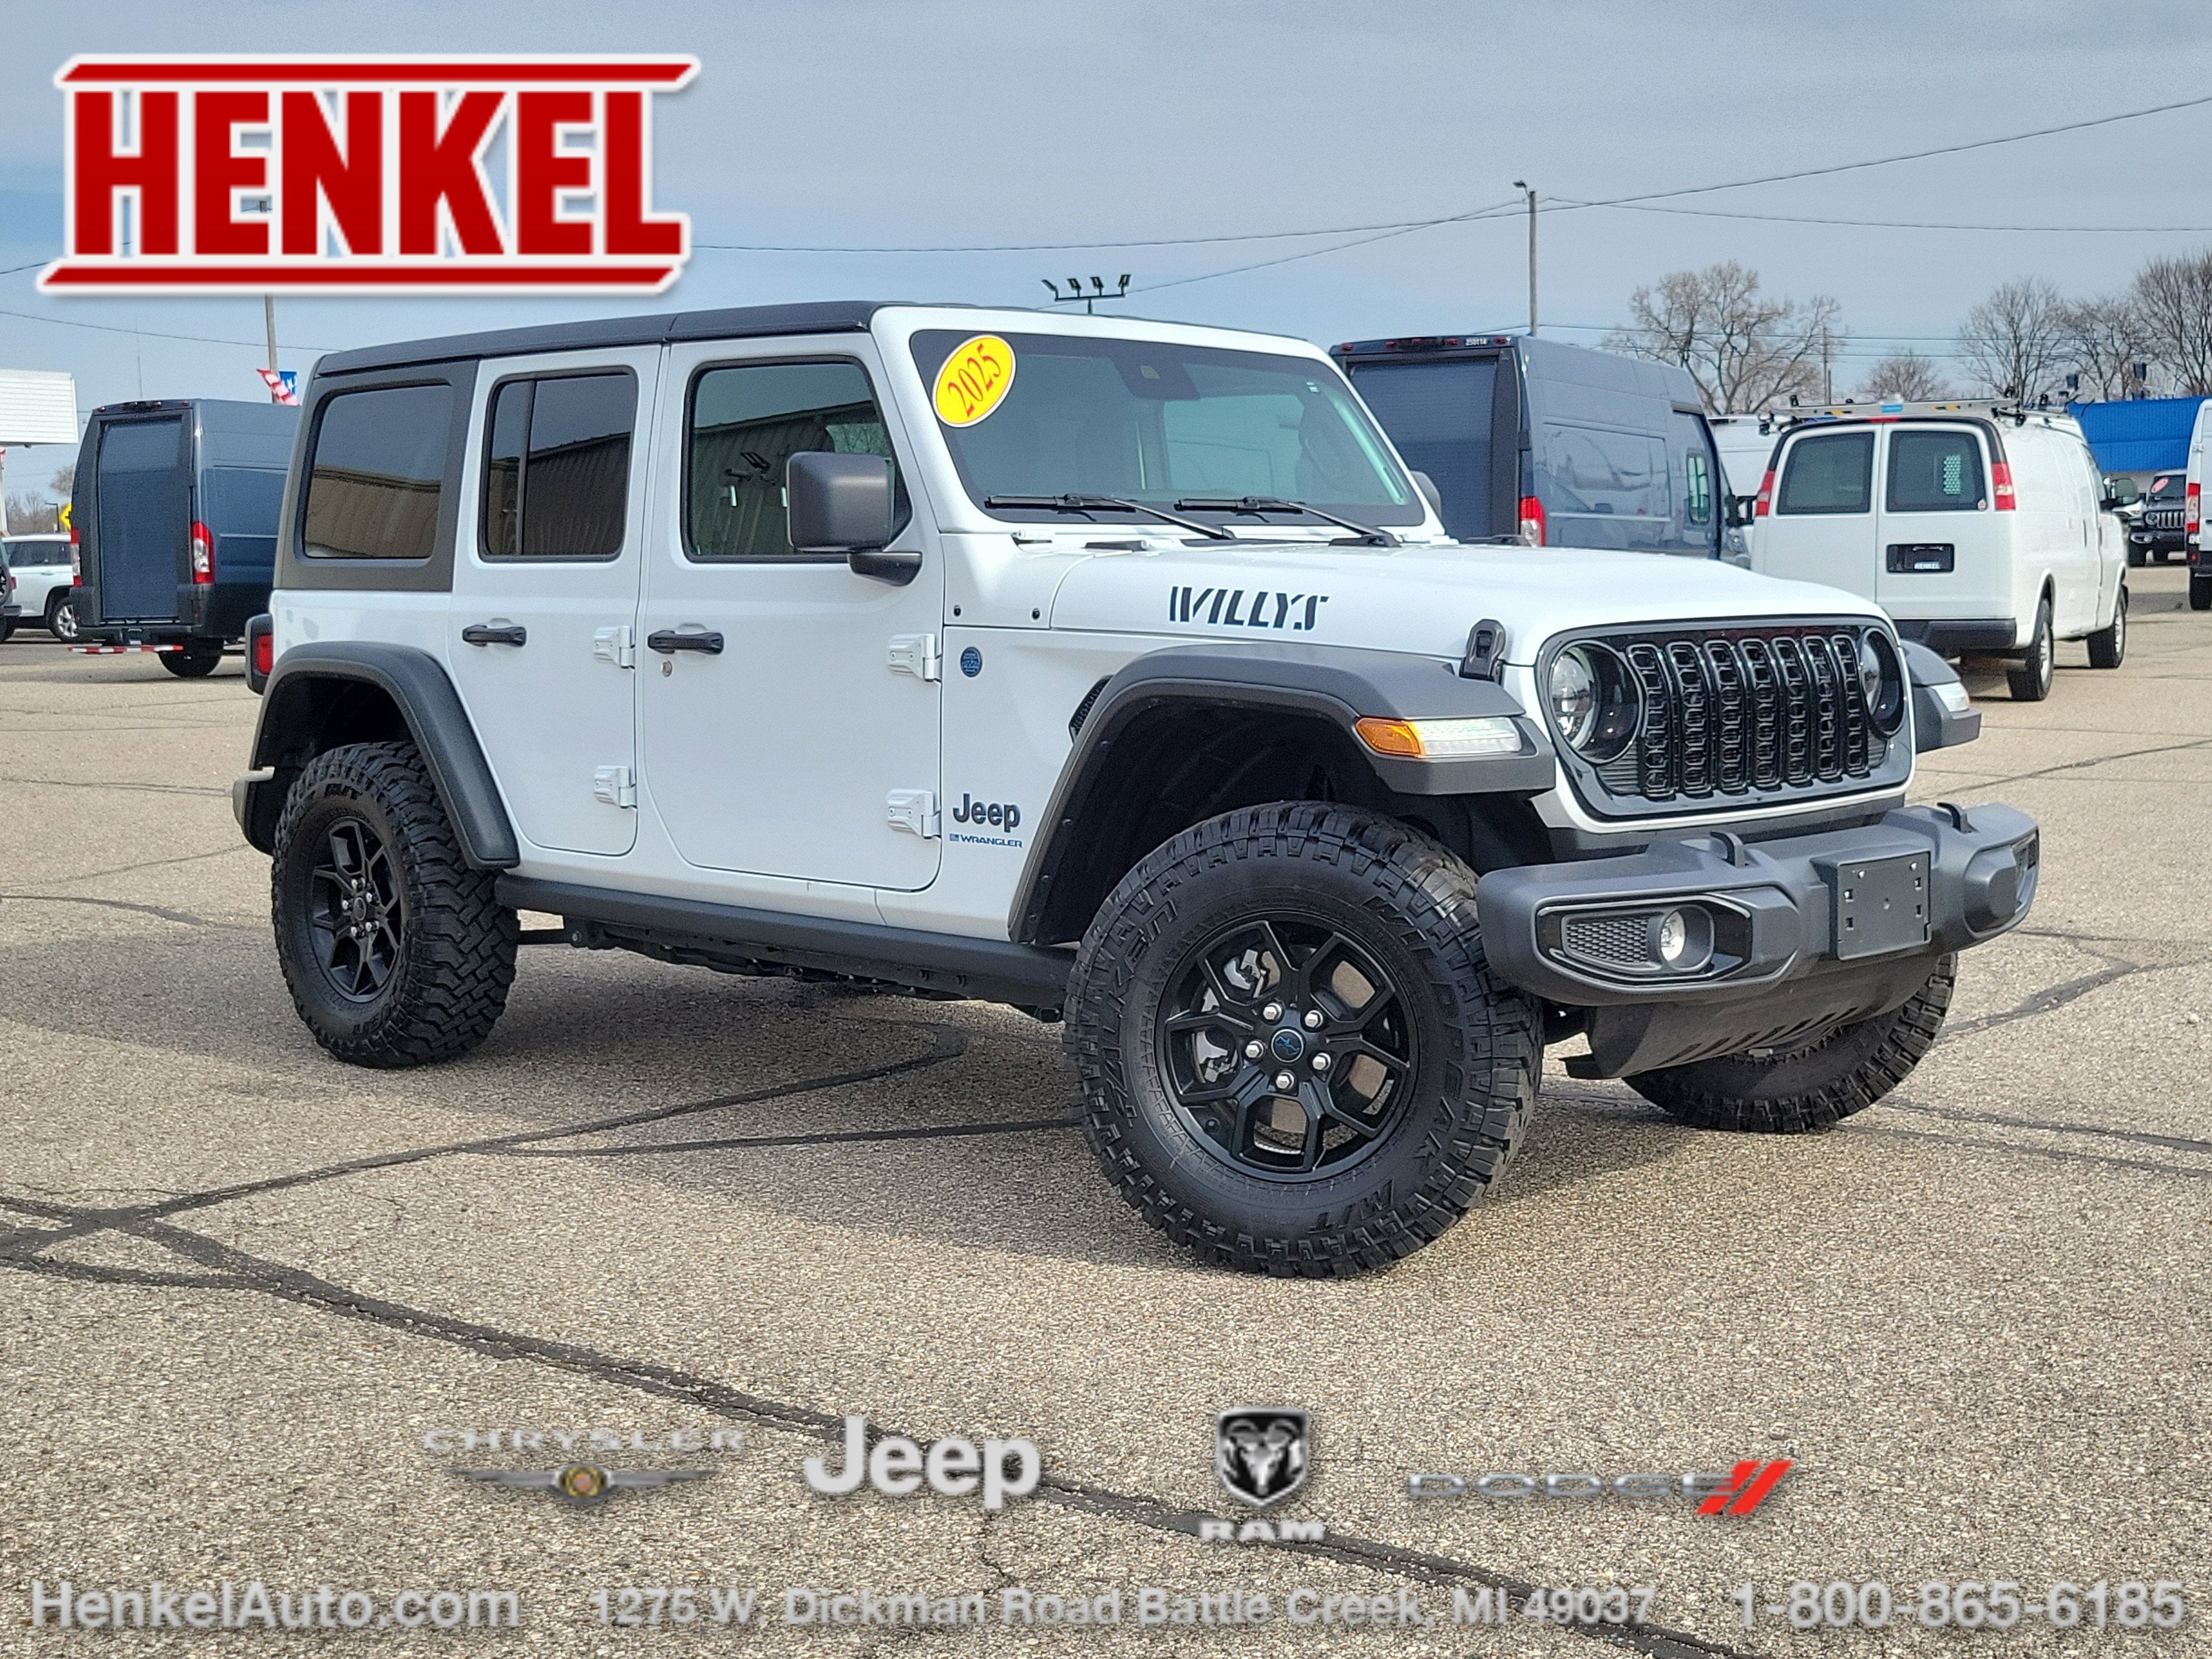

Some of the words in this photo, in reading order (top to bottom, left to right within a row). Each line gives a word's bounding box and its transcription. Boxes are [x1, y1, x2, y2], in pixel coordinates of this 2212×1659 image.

[948, 343, 1001, 417] 2025
[1169, 586, 1329, 630] WILLYS
[953, 793, 1020, 833] Jeep
[960, 834, 1023, 848] WRANGLER
